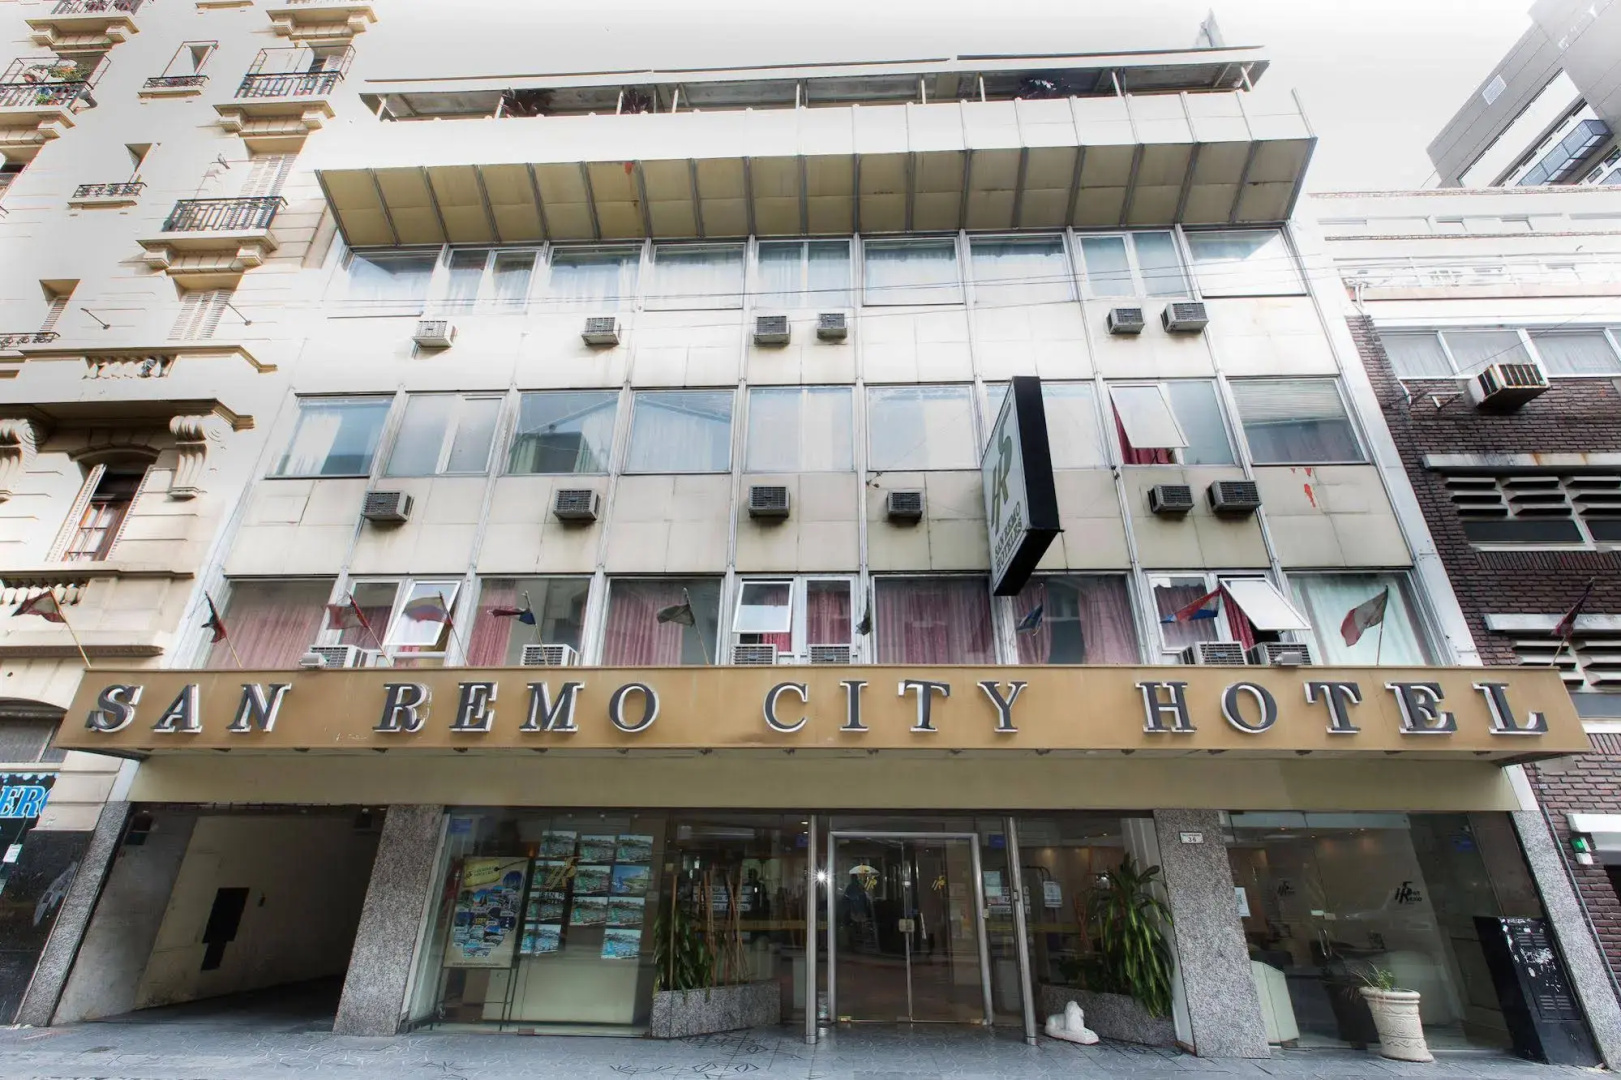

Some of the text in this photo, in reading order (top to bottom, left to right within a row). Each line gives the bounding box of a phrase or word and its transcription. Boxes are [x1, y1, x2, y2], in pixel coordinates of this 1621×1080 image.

[996, 514, 1022, 575] HOTELES
[1003, 500, 1021, 543] REMO
[85, 679, 1549, 734] SAN REMO CITY HOTEL
[0, 785, 50, 819] ER
